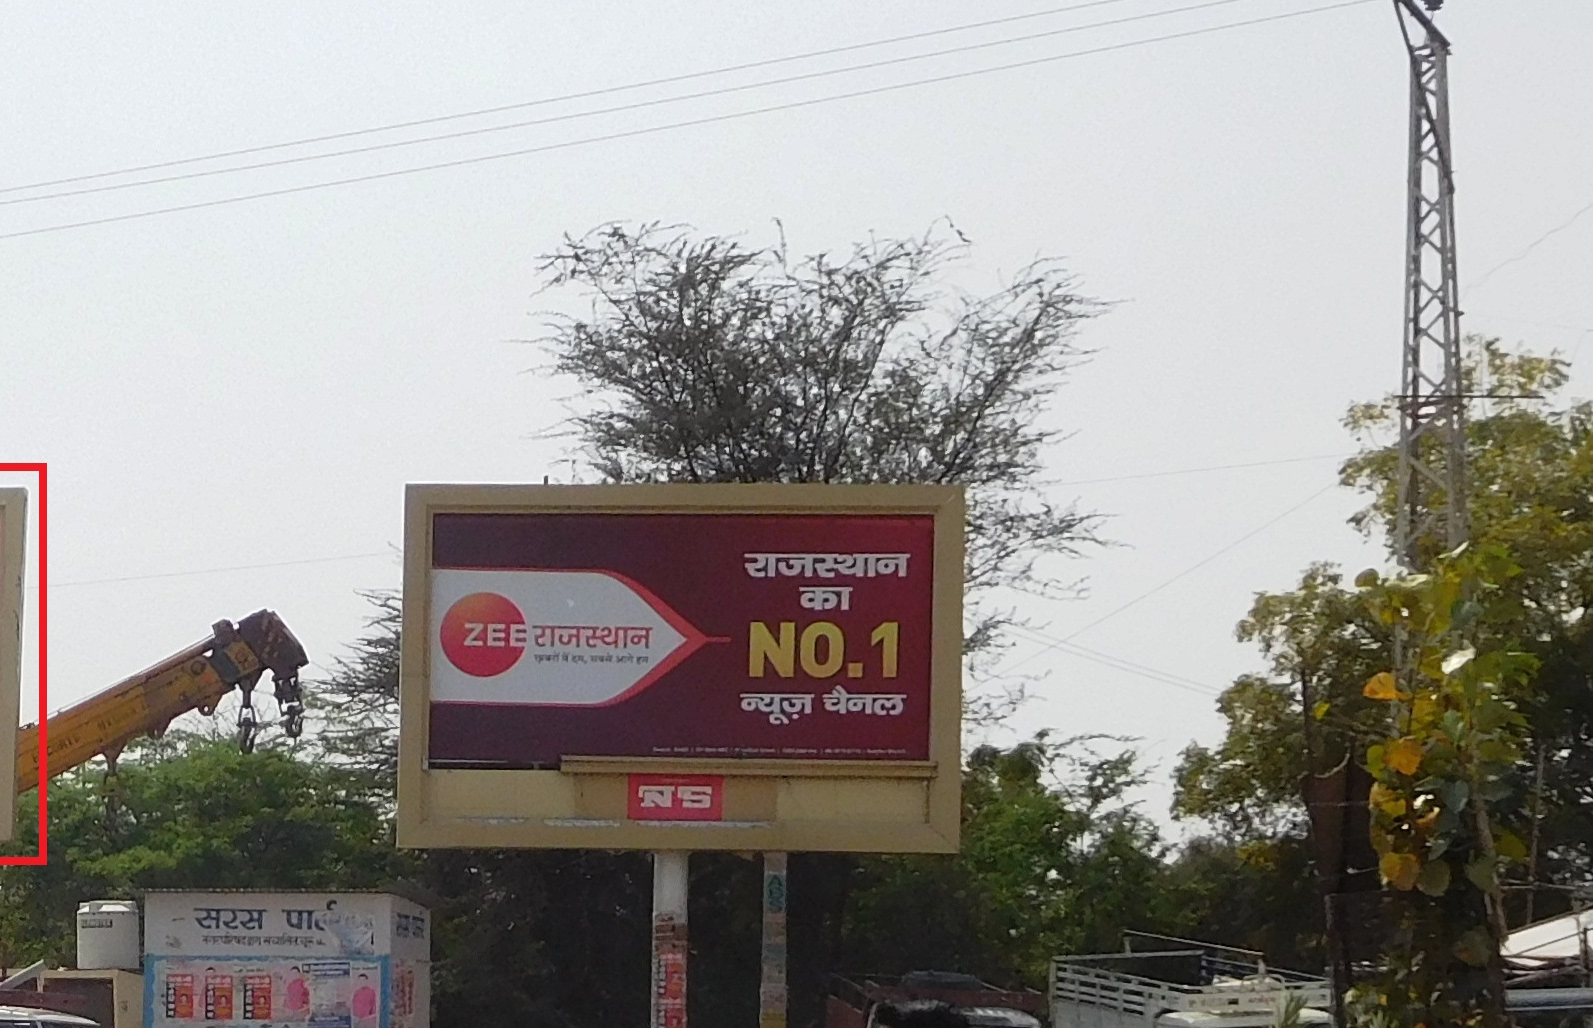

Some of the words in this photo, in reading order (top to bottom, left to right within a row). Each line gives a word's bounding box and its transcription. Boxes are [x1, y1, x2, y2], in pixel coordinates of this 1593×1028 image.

[744, 553, 911, 578] राजस्थान
[799, 586, 853, 611] का
[463, 622, 527, 648] ZEE
[532, 625, 653, 649] राजस्थान
[748, 621, 899, 679] NO.1
[740, 693, 815, 725] न्यूज़
[822, 685, 907, 715] चैनल
[193, 908, 267, 930] सरस
